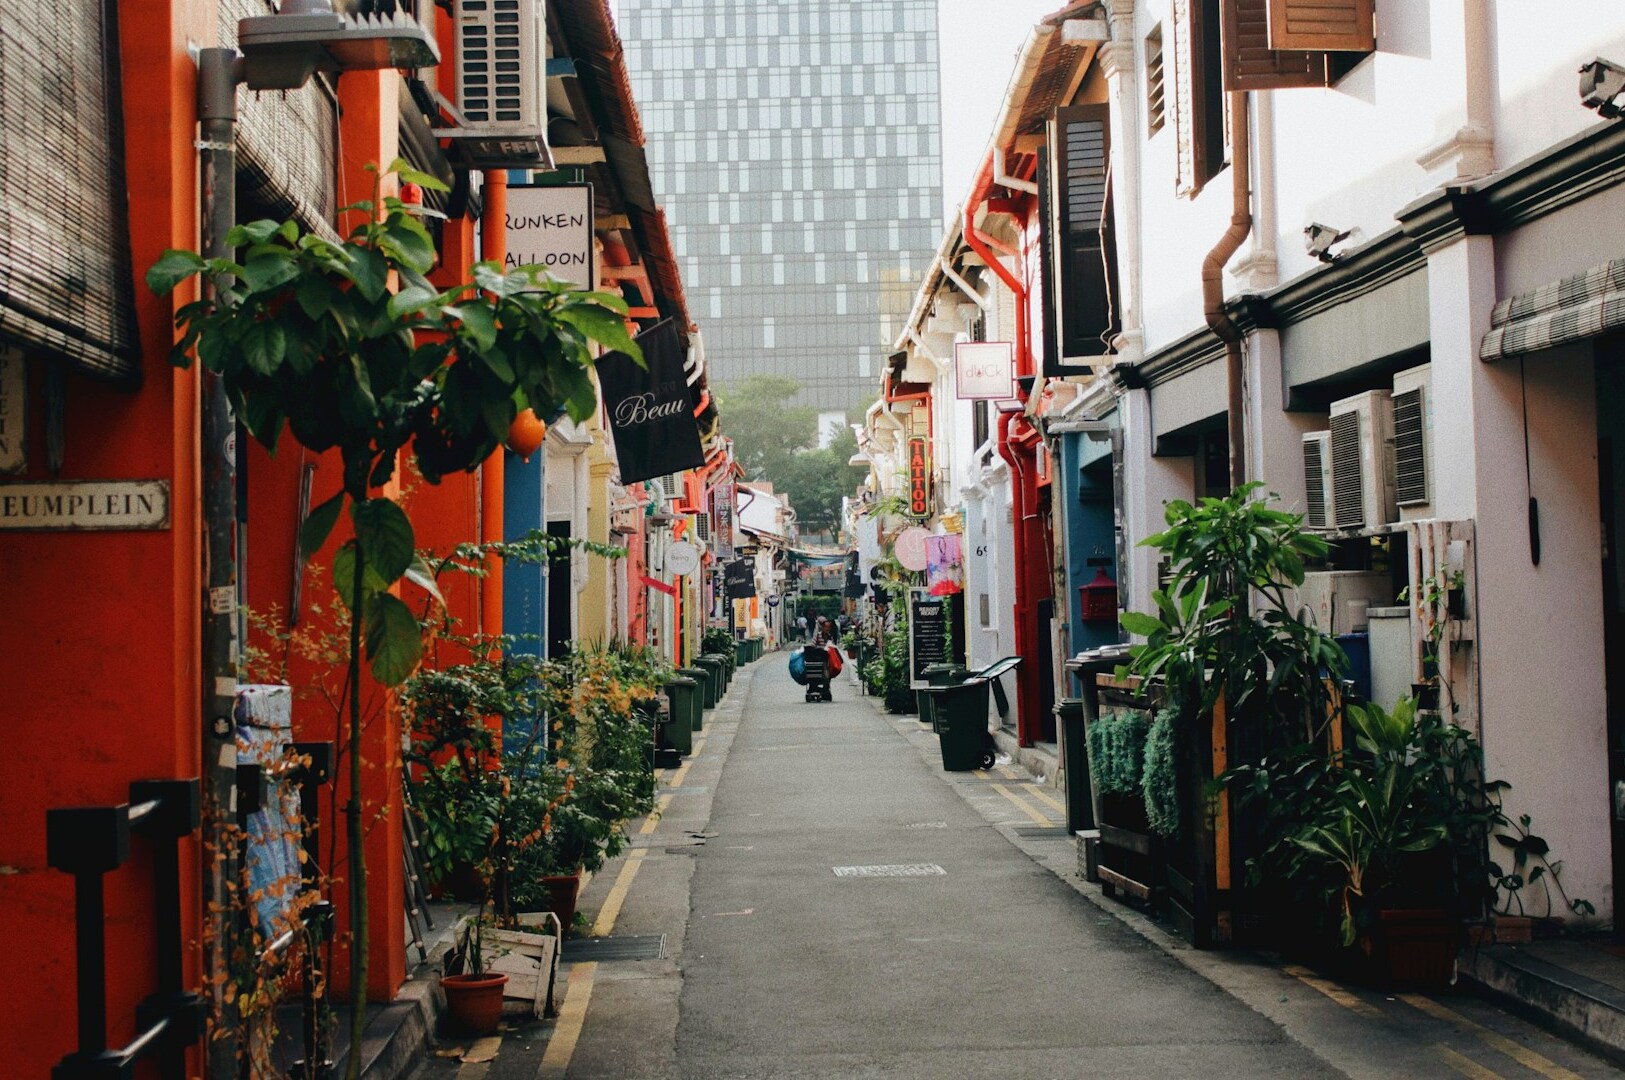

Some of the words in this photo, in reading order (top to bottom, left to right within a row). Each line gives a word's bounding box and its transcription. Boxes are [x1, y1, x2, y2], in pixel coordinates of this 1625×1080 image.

[615, 392, 686, 428] Beau
[908, 441, 926, 513] TATTOO
[3, 493, 154, 517] EUMPLEIN
